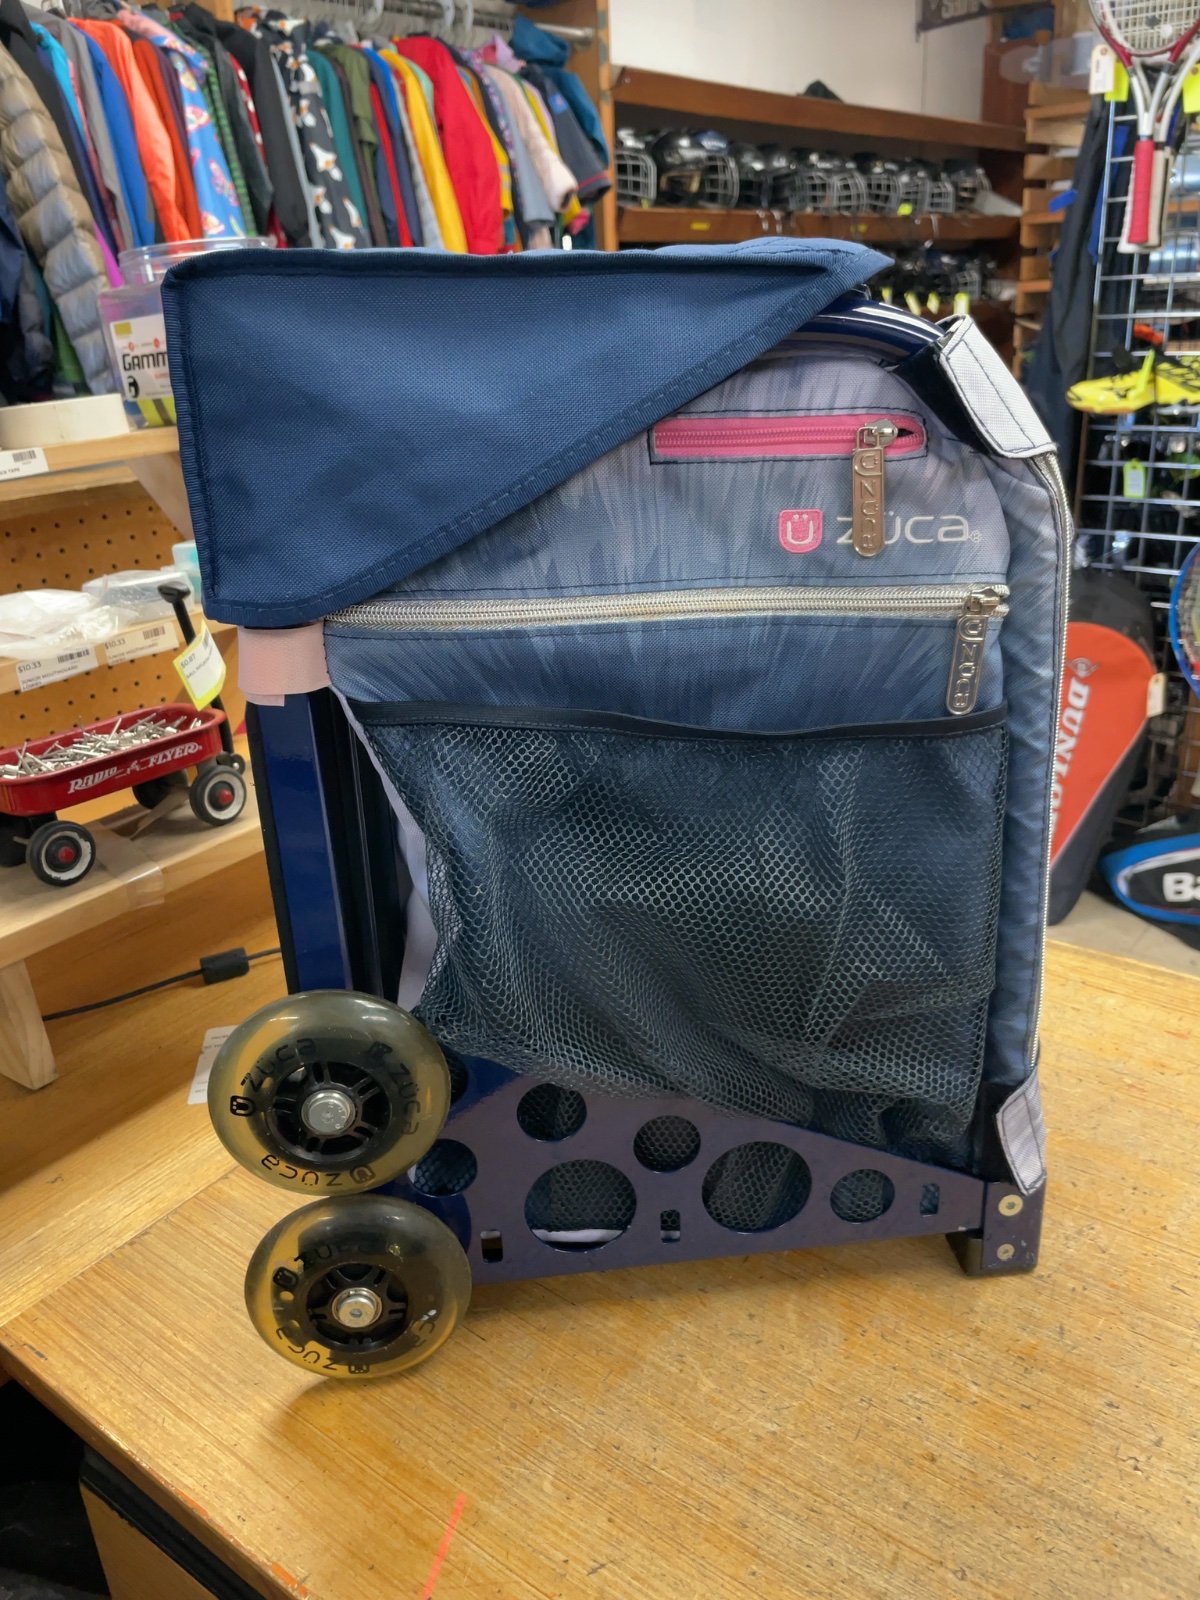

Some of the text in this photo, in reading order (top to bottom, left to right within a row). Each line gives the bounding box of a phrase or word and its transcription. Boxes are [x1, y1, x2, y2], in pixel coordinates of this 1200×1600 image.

[105, 638, 126, 650] $10.33
[18, 661, 42, 673] $10.33
[42, 665, 79, 679] MOUTHGUARD
[1050, 677, 1090, 833] DUNLO
[68, 742, 200, 794] RADIO FLYER
